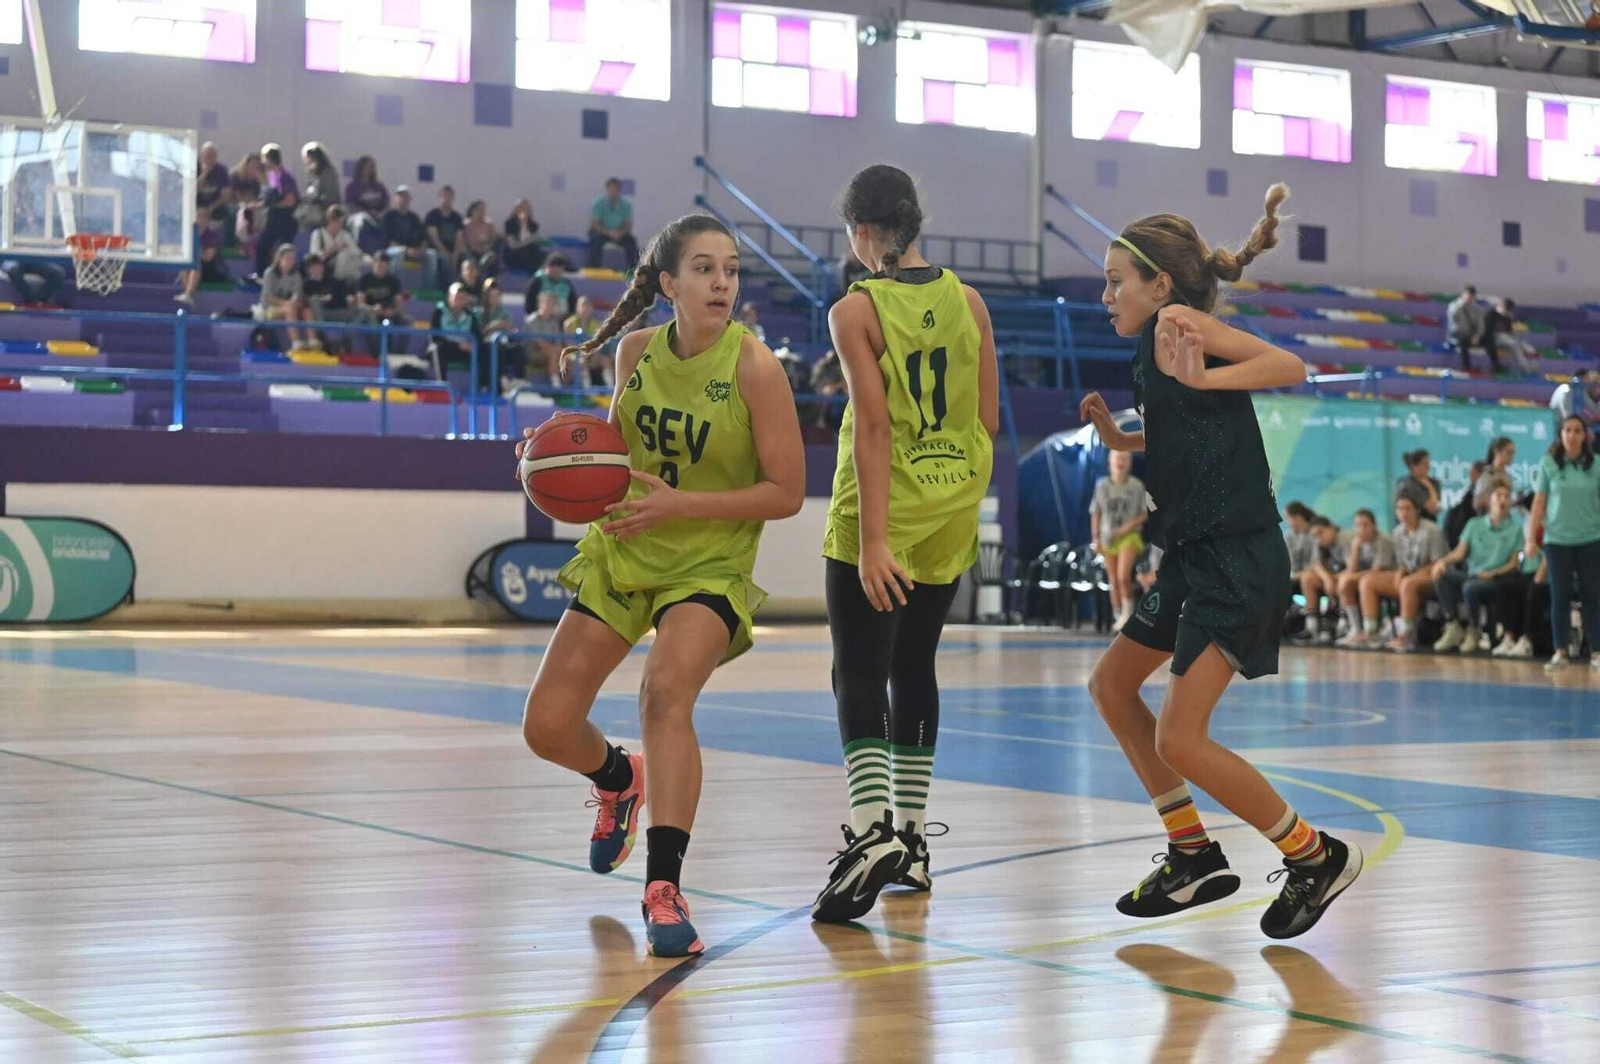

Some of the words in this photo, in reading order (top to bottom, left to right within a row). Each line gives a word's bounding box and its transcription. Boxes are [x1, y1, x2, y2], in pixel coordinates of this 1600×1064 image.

[905, 346, 947, 439] 11
[635, 404, 711, 465] SEV
[917, 469, 977, 485] SEVILLA
